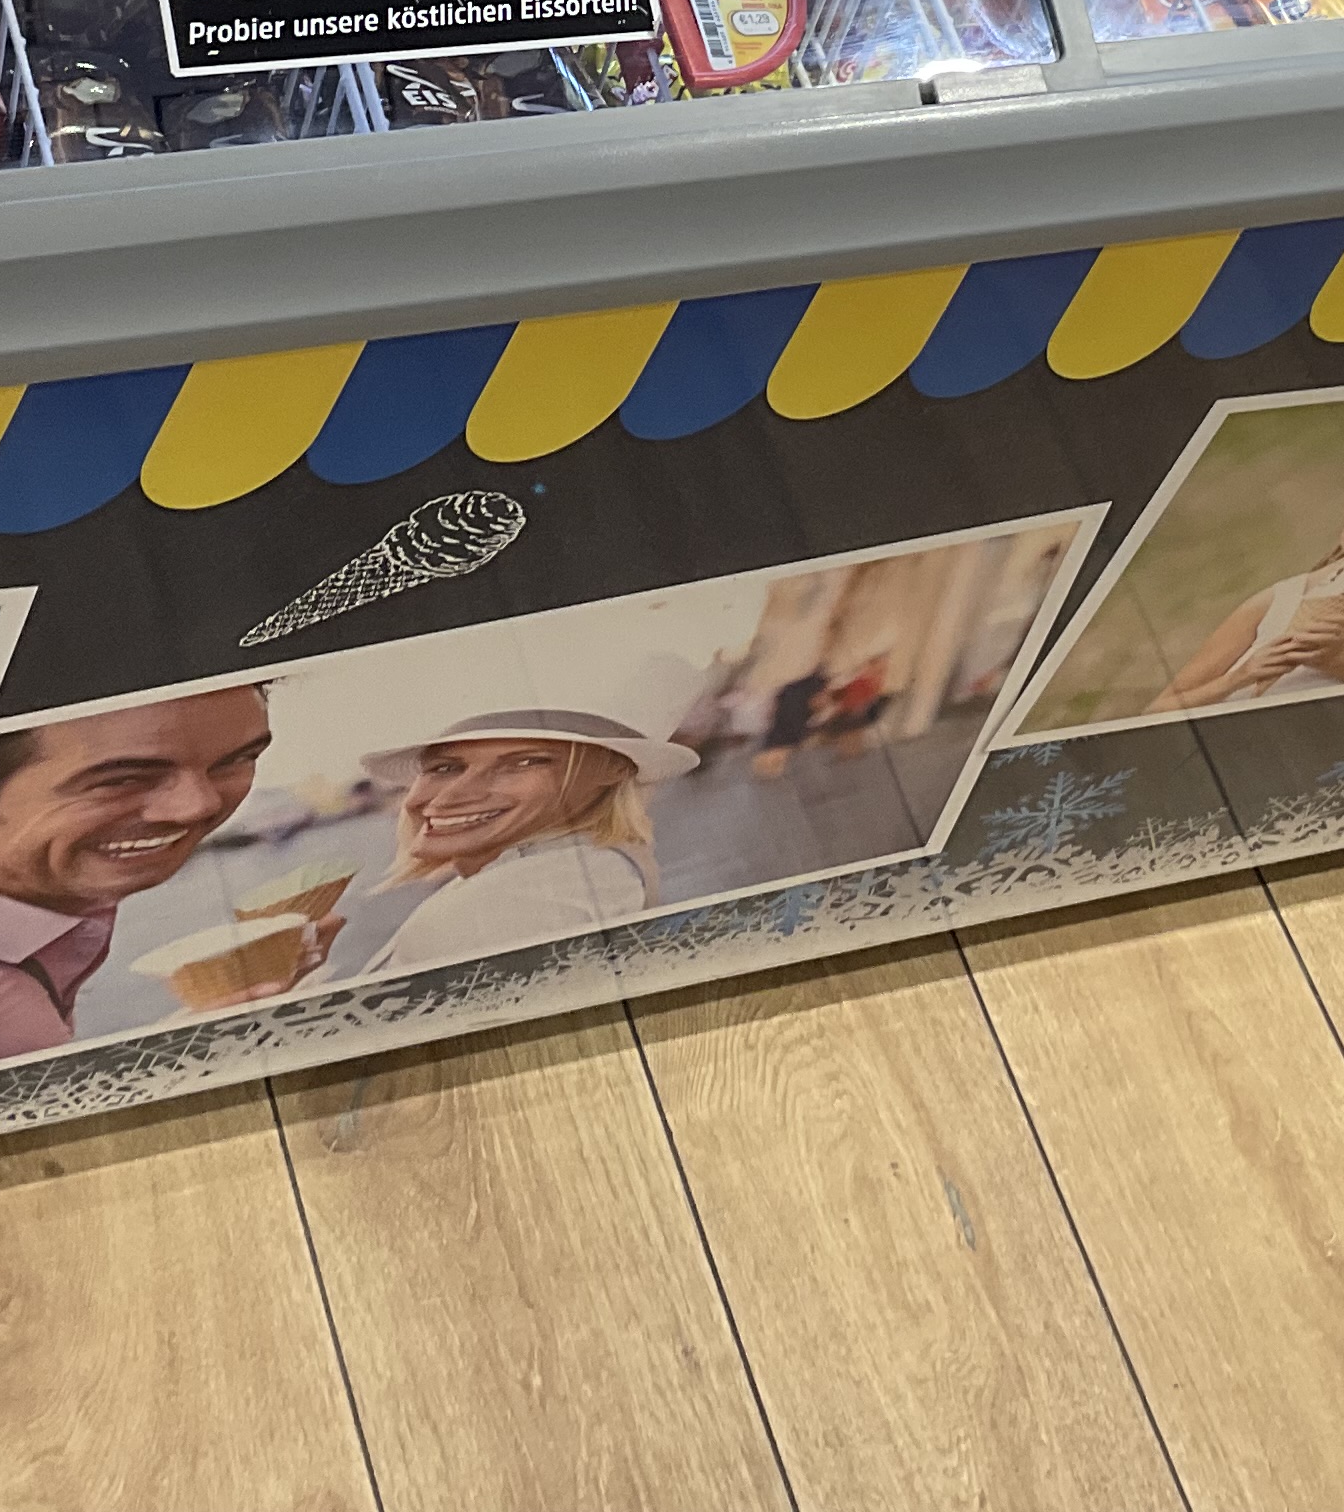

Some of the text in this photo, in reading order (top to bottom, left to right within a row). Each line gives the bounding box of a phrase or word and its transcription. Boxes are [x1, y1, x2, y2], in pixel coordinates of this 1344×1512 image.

[189, 15, 285, 46] Probier
[293, 12, 379, 37] unsere
[387, 1, 512, 30] köstlichen
[402, 88, 457, 109] EIS
